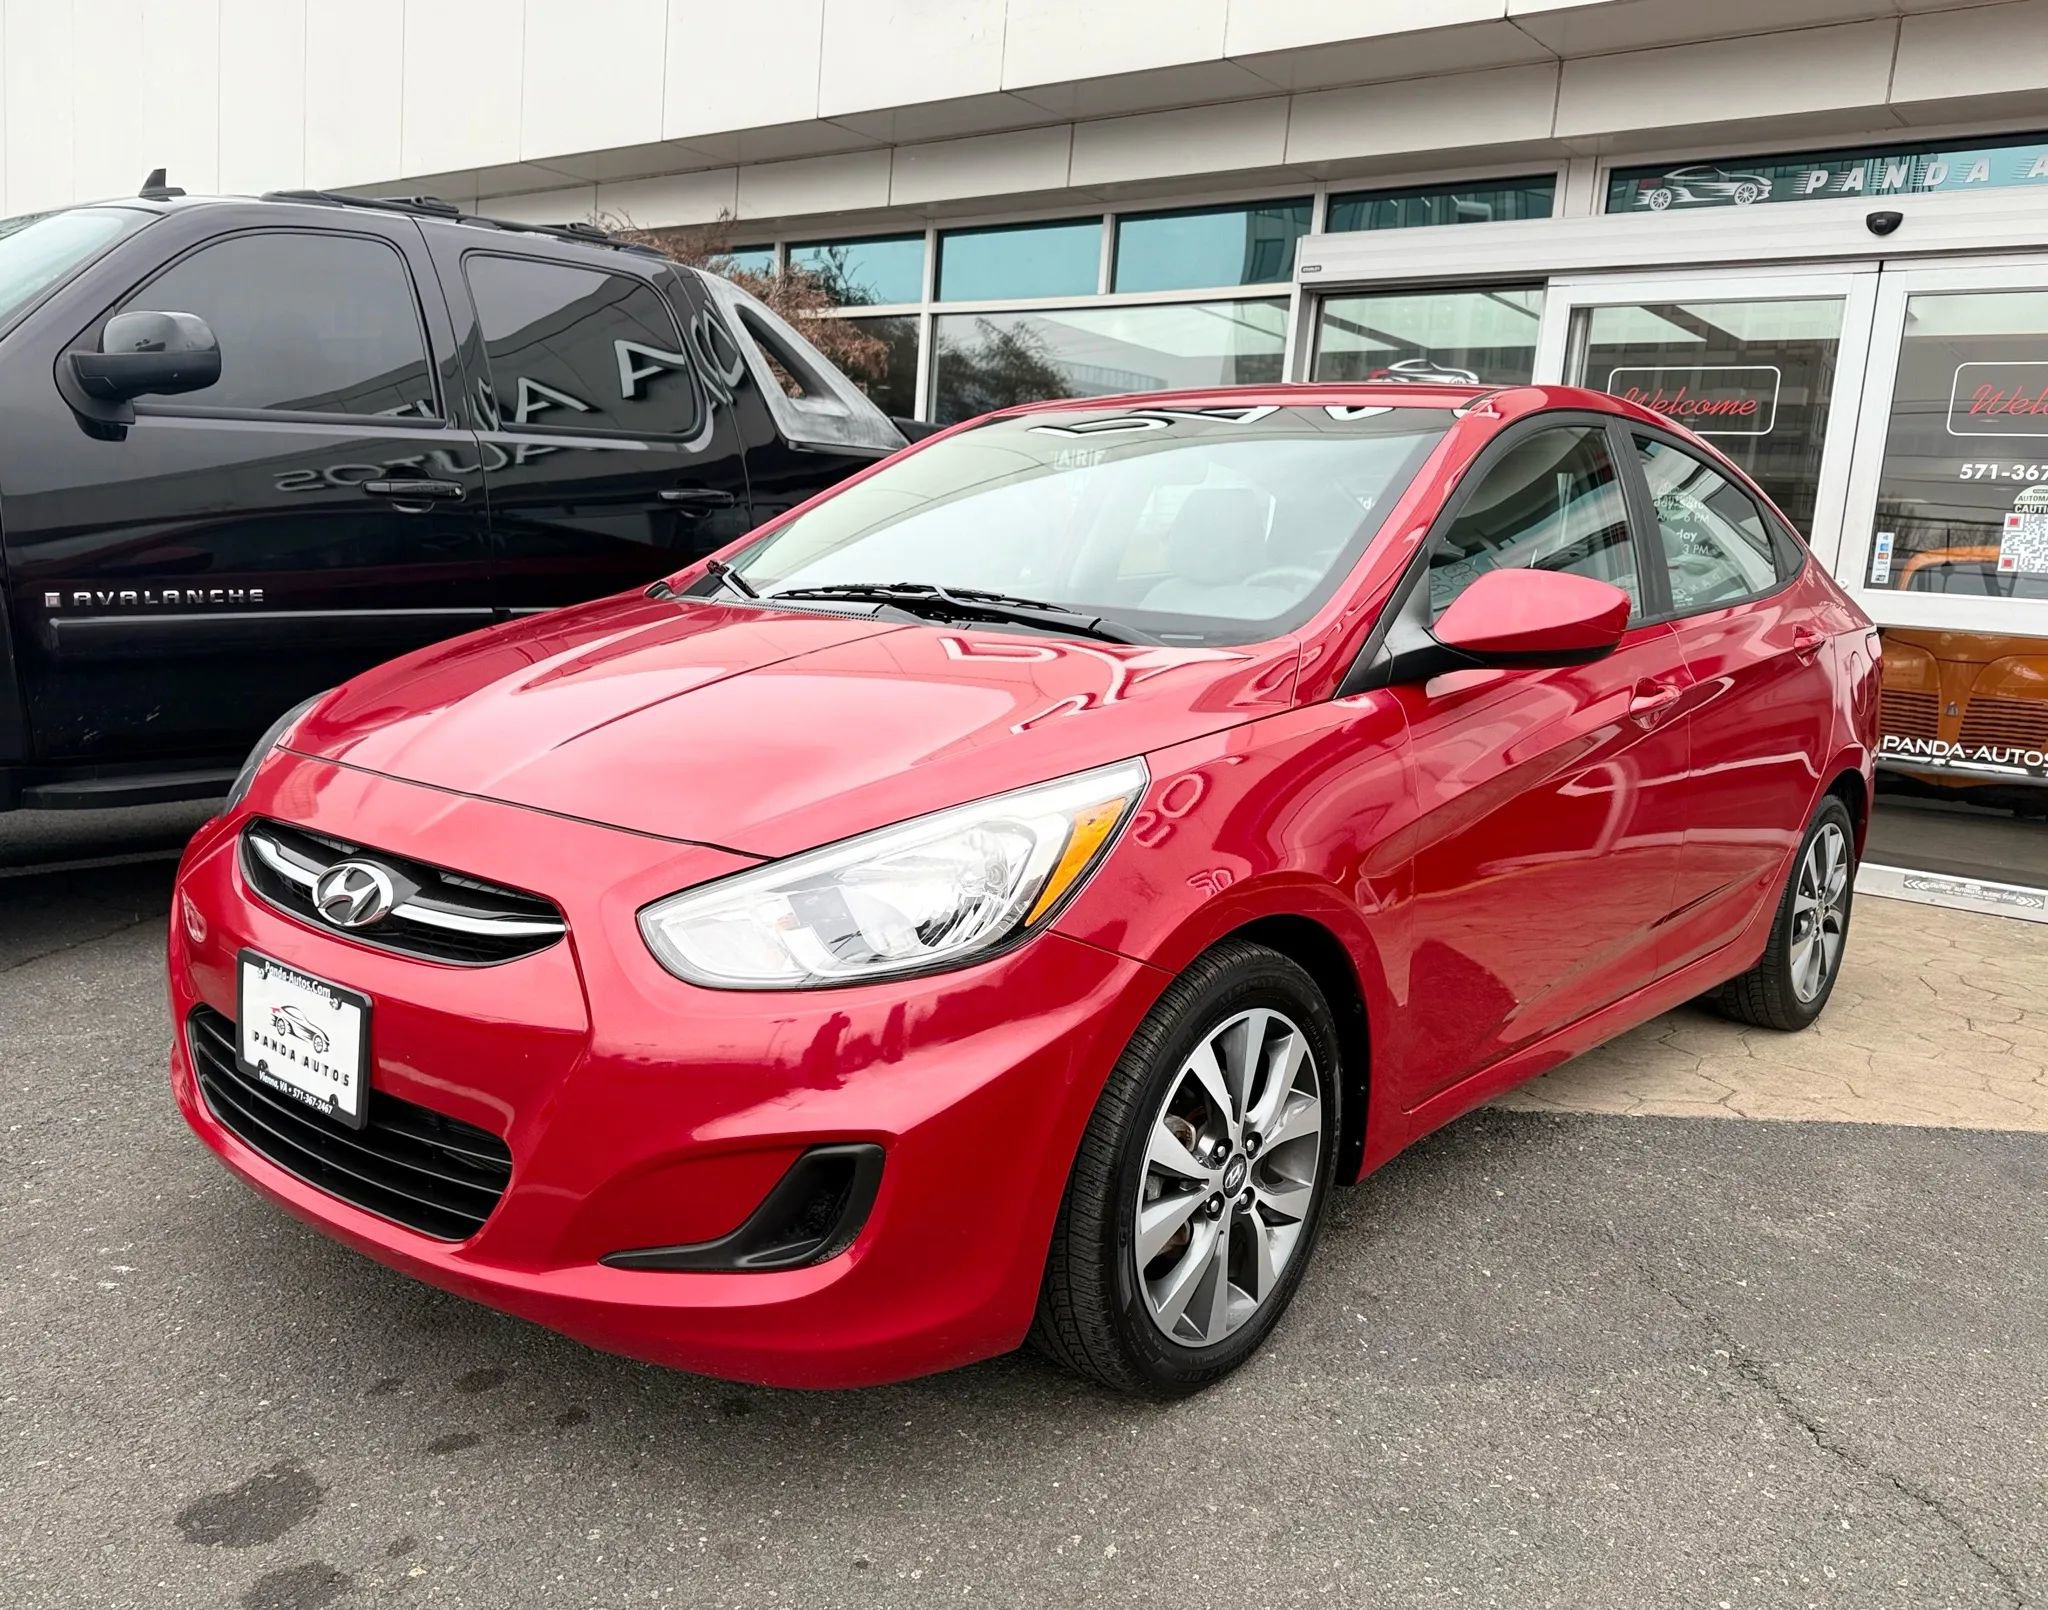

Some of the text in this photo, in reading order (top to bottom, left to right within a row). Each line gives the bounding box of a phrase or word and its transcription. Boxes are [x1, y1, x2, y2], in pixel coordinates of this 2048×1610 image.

[1803, 157, 1990, 194] PANDA
[1623, 386, 1758, 416] Welcome
[1694, 512, 1710, 524] PM
[2014, 504, 2048, 514] CAUTI
[1692, 543, 1710, 555] PM
[73, 588, 264, 606] AVALANCHE
[264, 961, 331, 999] Panda-Autos.Com
[252, 1030, 350, 1087] PANDA AUTOS
[279, 1080, 288, 1094] VA
[292, 1087, 333, 1115] 571-367-2467
